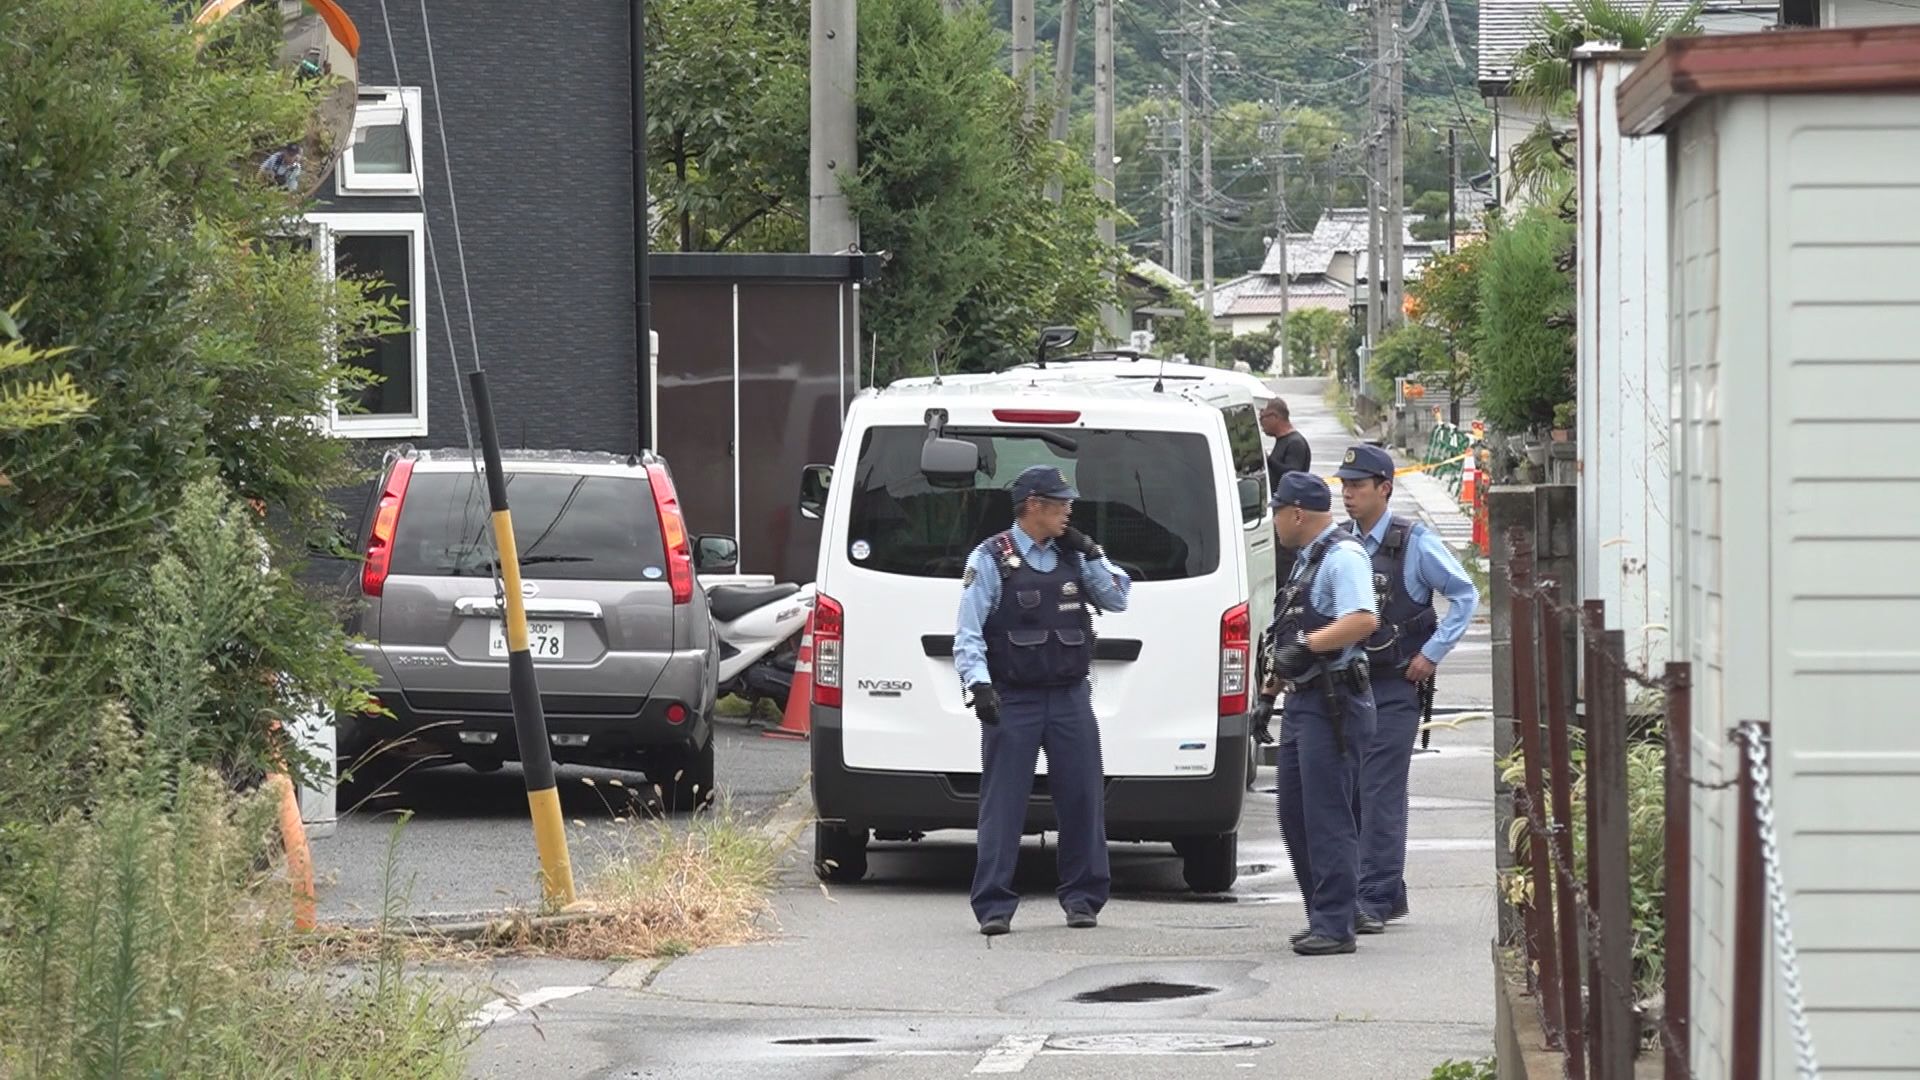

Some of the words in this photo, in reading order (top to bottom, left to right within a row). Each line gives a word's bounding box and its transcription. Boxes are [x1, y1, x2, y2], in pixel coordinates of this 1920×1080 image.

[529, 623, 548, 634] 300
[530, 636, 559, 655] -78
[858, 680, 912, 690] NV350
